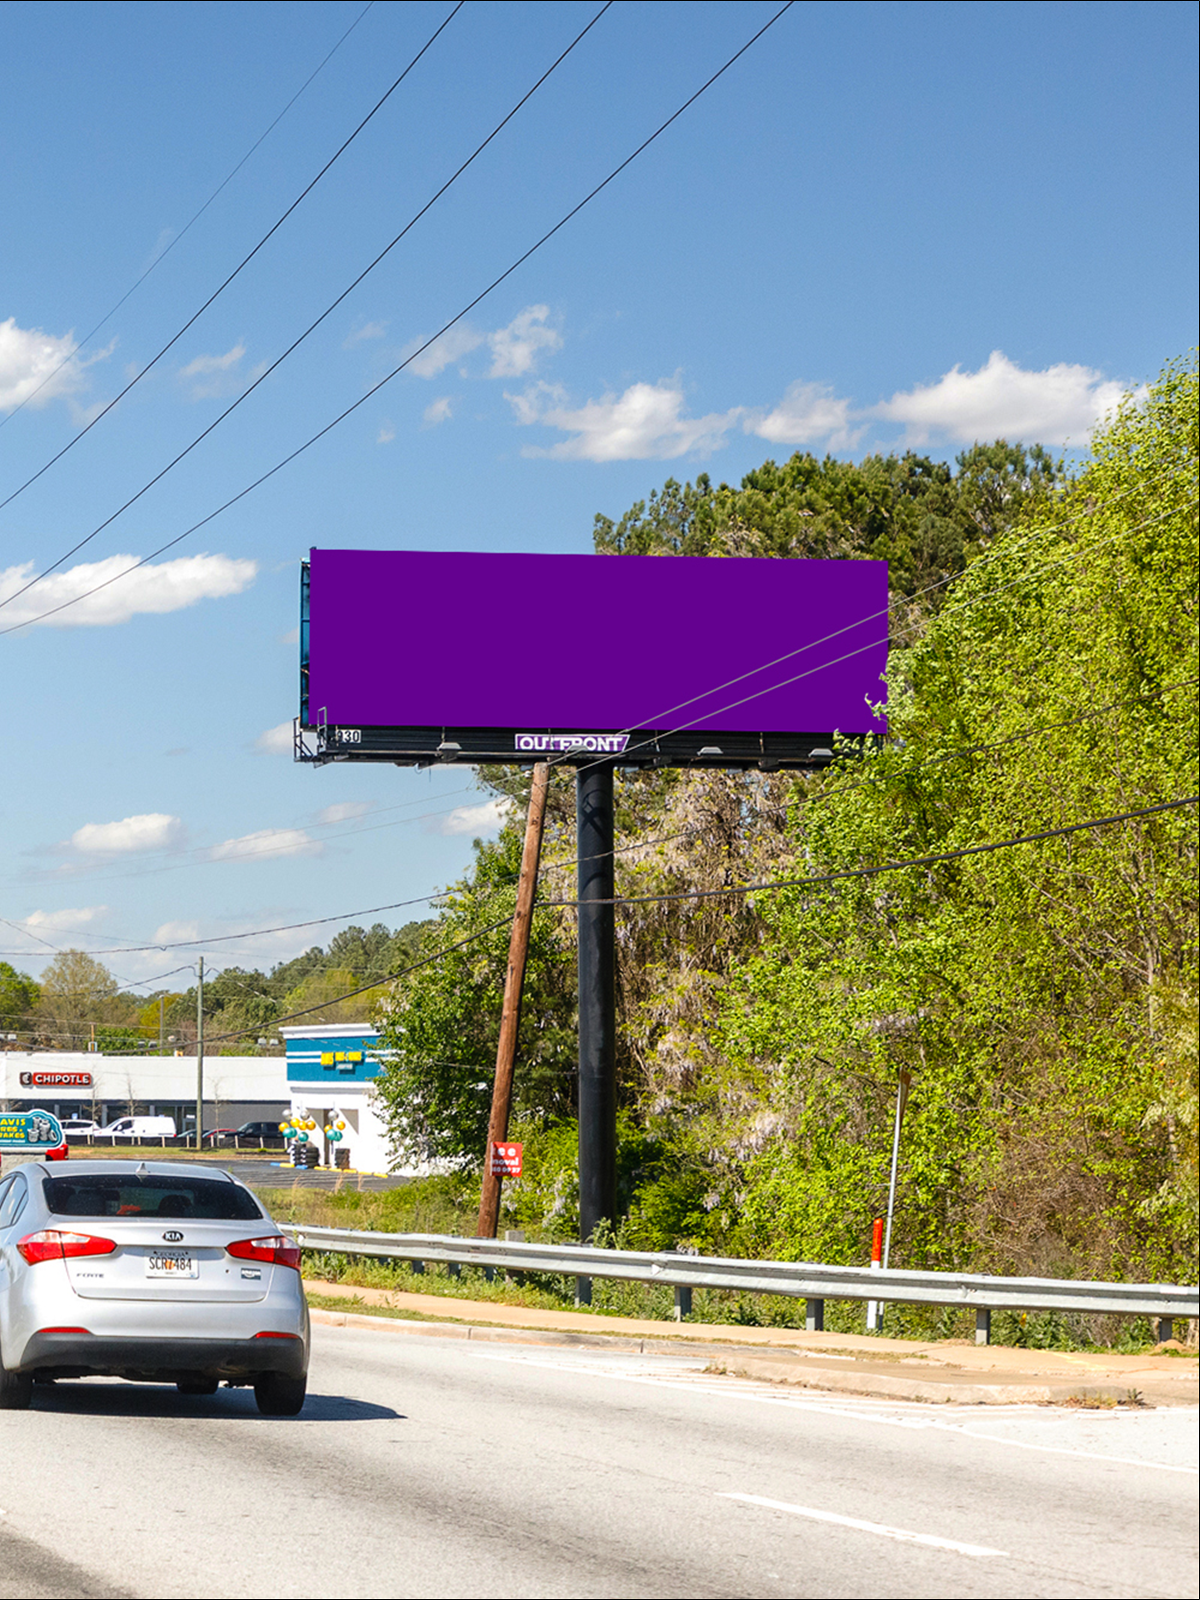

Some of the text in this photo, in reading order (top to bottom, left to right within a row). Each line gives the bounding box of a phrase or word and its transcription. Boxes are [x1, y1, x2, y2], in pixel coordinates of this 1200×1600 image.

[35, 1074, 89, 1084] CHIPOTLE
[164, 1232, 182, 1241] KIA
[149, 1256, 192, 1270] SCR7484
